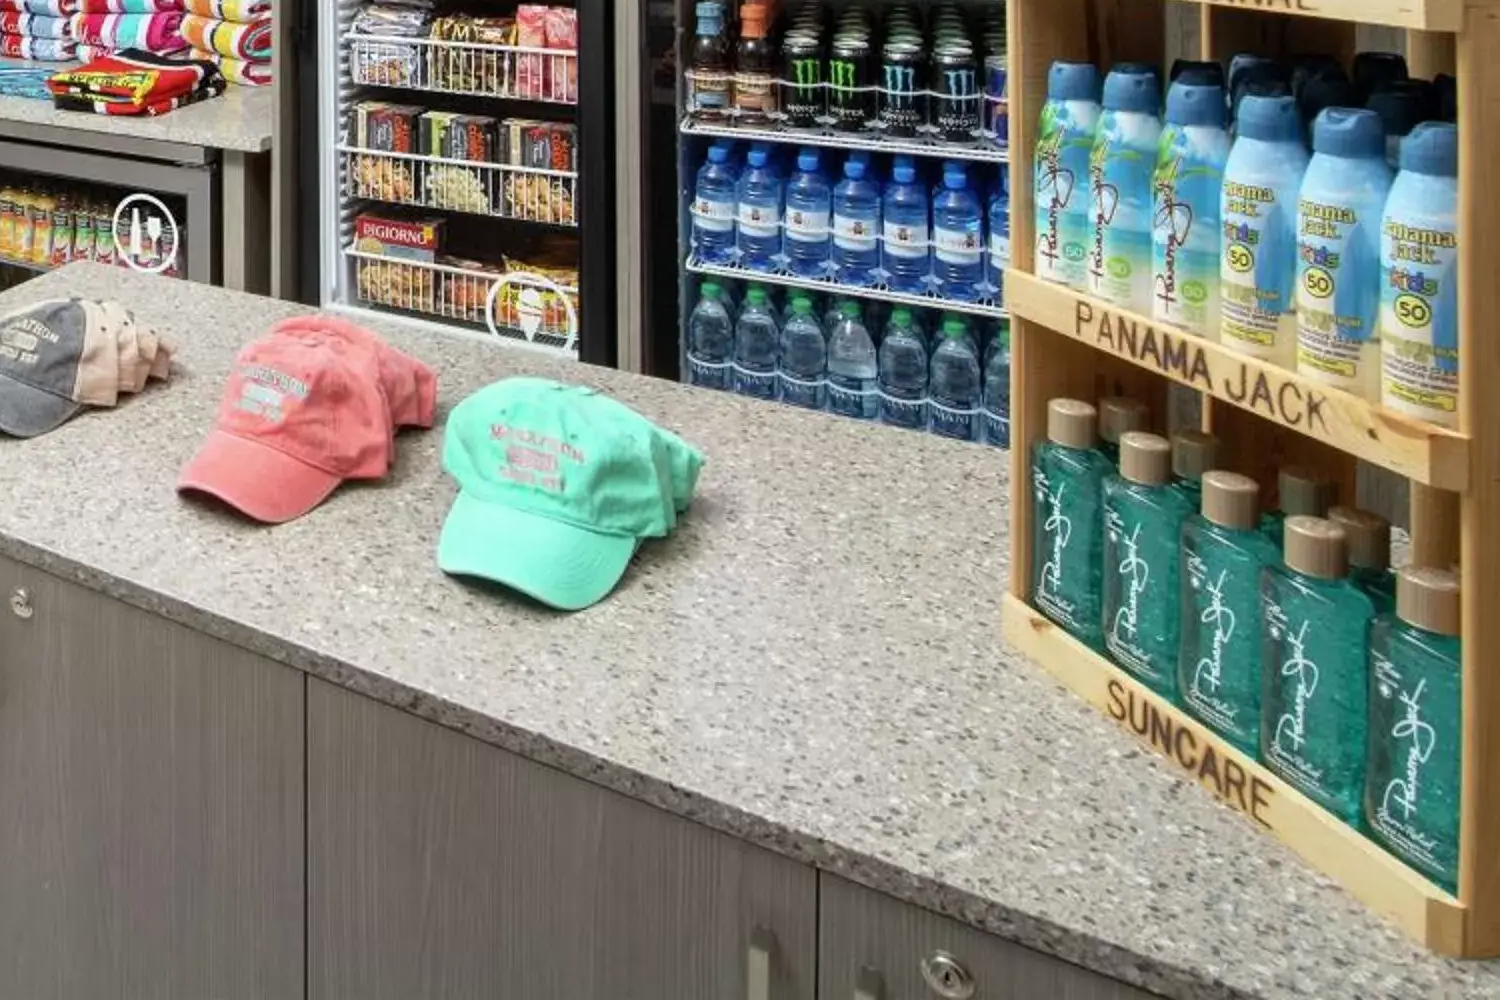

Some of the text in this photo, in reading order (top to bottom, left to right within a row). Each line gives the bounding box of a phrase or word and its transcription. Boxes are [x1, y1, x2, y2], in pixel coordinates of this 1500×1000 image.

[1230, 249, 1249, 268] 50
[1307, 274, 1329, 294] 50
[1389, 266, 1438, 296] kids
[1398, 301, 1426, 321] 50
[1073, 299, 1215, 391] PANAMA
[1223, 366, 1328, 429] JACK
[1106, 679, 1276, 830] SUNCARE
